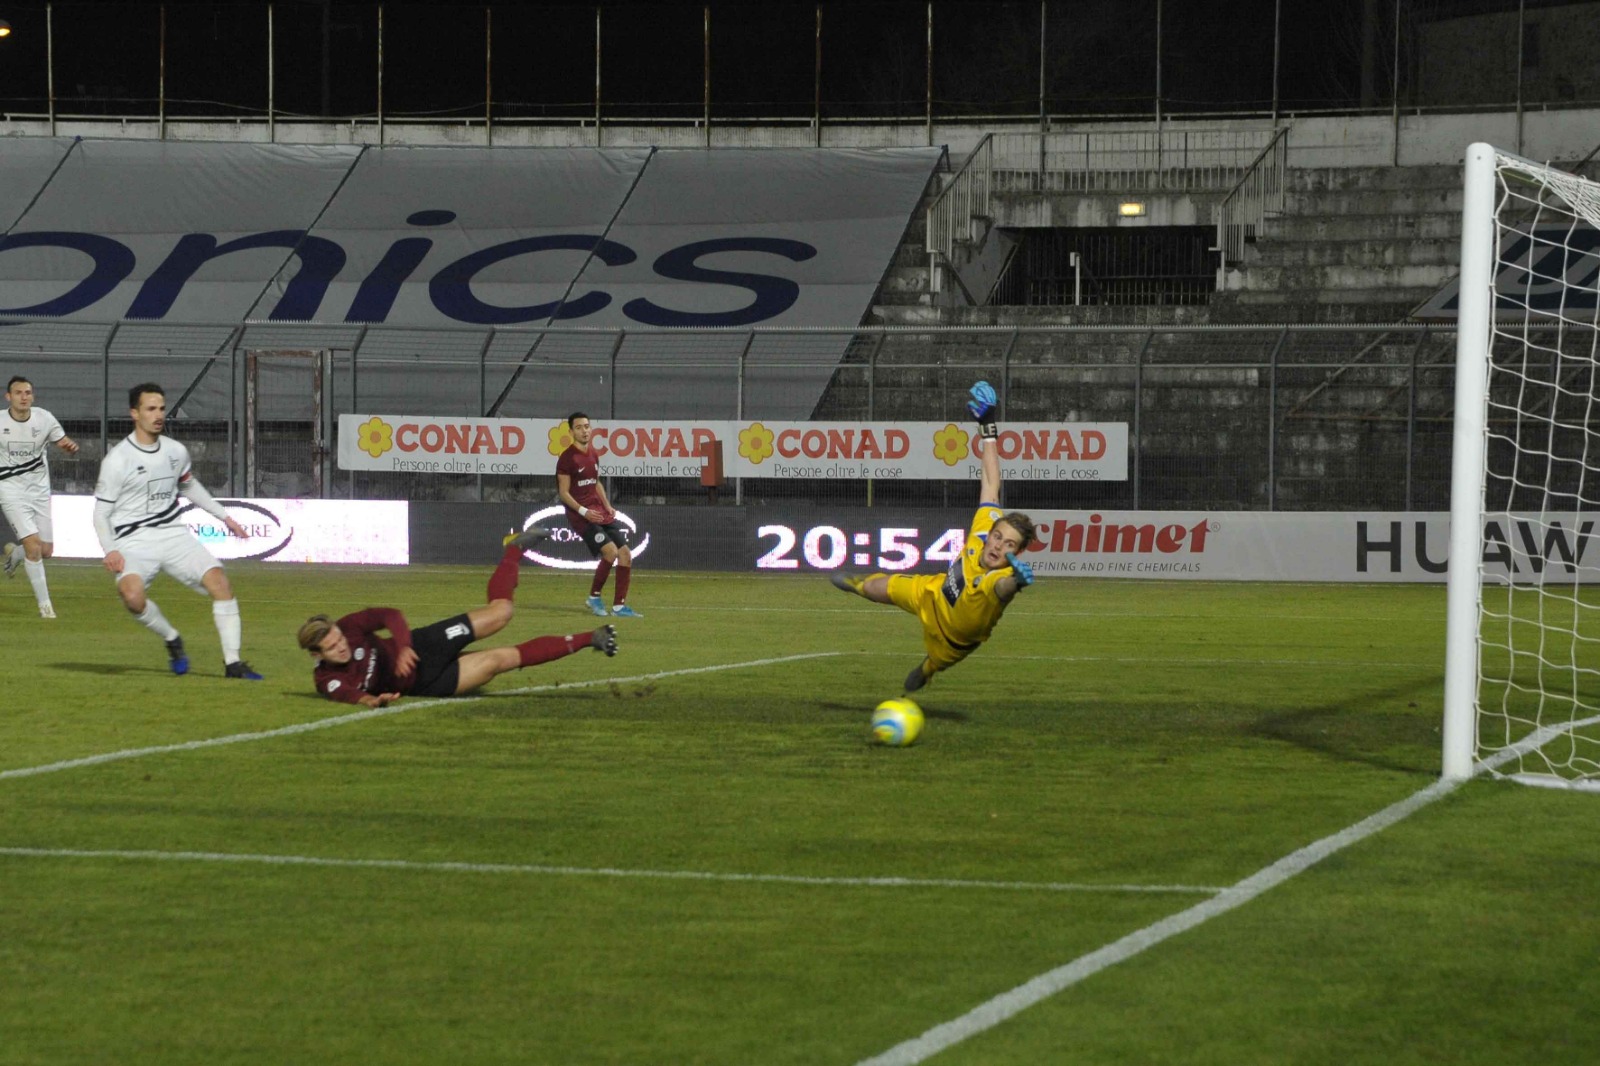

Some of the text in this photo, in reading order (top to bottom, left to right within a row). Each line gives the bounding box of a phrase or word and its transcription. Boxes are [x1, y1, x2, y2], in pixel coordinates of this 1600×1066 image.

[396, 424, 525, 455] CONAD
[777, 429, 910, 459] CONAD
[393, 458, 518, 473] Persone oltre le cose
[600, 461, 702, 476] sone oltre le cos
[774, 463, 903, 478] Persone oltre le cose
[969, 464, 1099, 479] Pene oltre le cose
[1017, 514, 1211, 553] chimet
[756, 525, 965, 570] 20:54
[1081, 562, 1104, 571] AND
[1108, 562, 1133, 572] FINE
[1137, 562, 1200, 572] CHEMICALS
